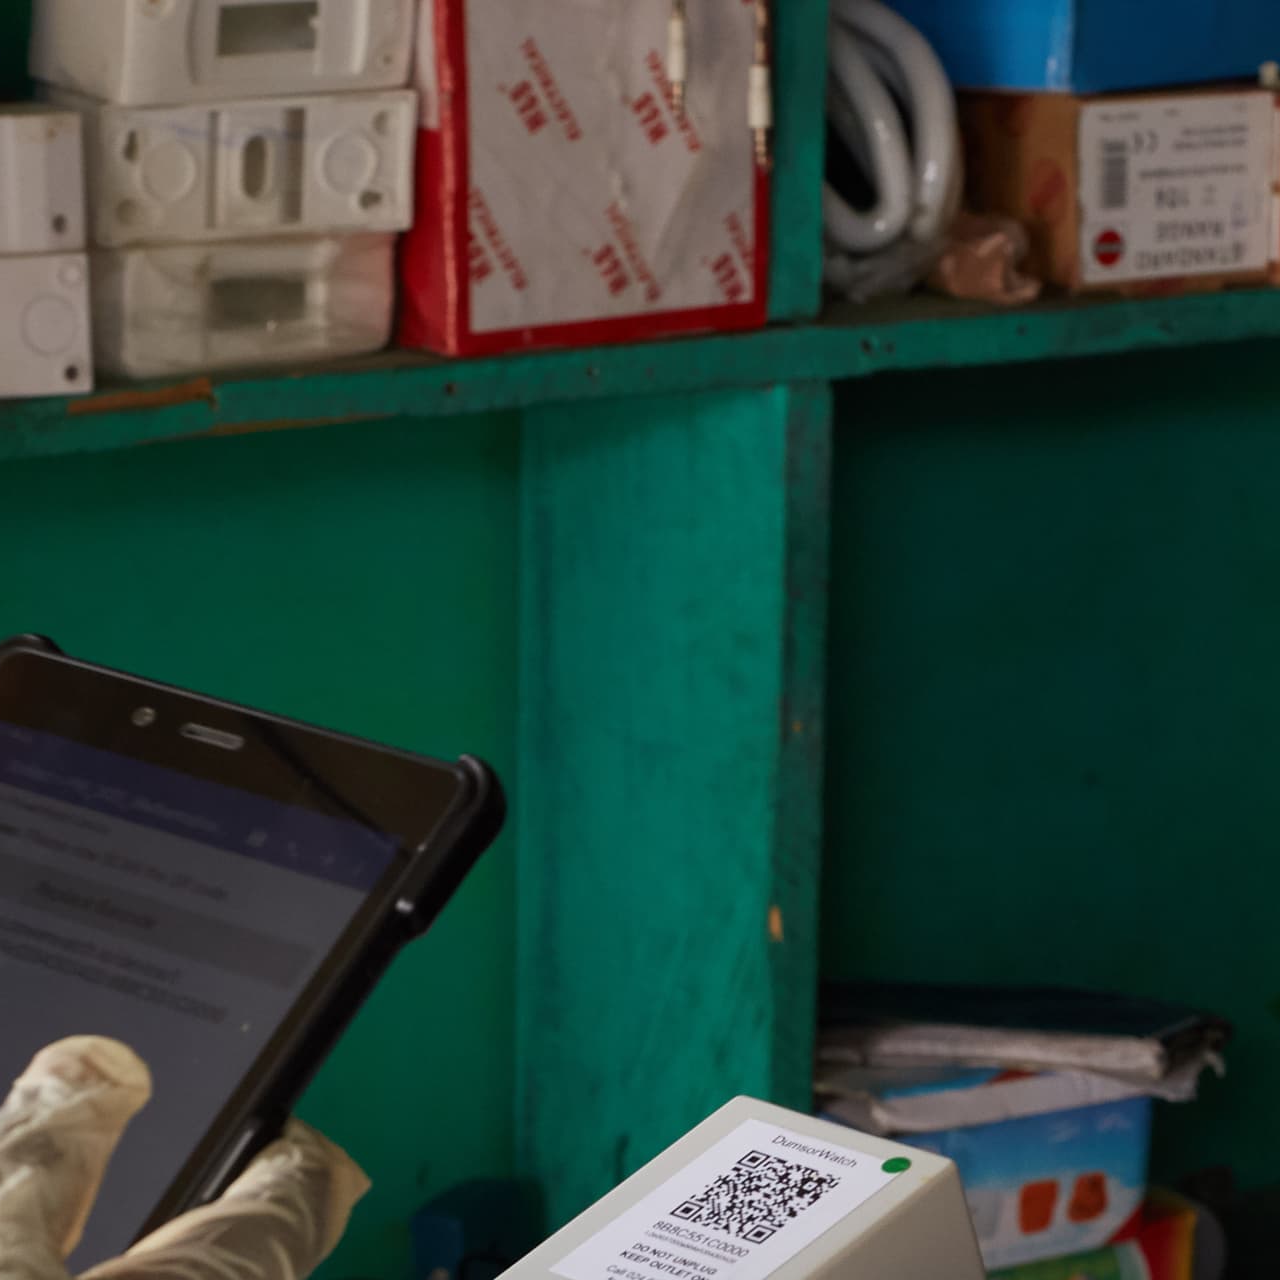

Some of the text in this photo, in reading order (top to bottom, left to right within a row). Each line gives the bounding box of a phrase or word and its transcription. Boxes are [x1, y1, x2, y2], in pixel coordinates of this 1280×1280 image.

[771, 1135, 857, 1168] DumsorWatch
[606, 1264, 626, 1276] Call
[619, 1250, 650, 1264] KEEP
[649, 1260, 692, 1278] OUTLET
[632, 1242, 718, 1275] DO NOT UNPLUG
